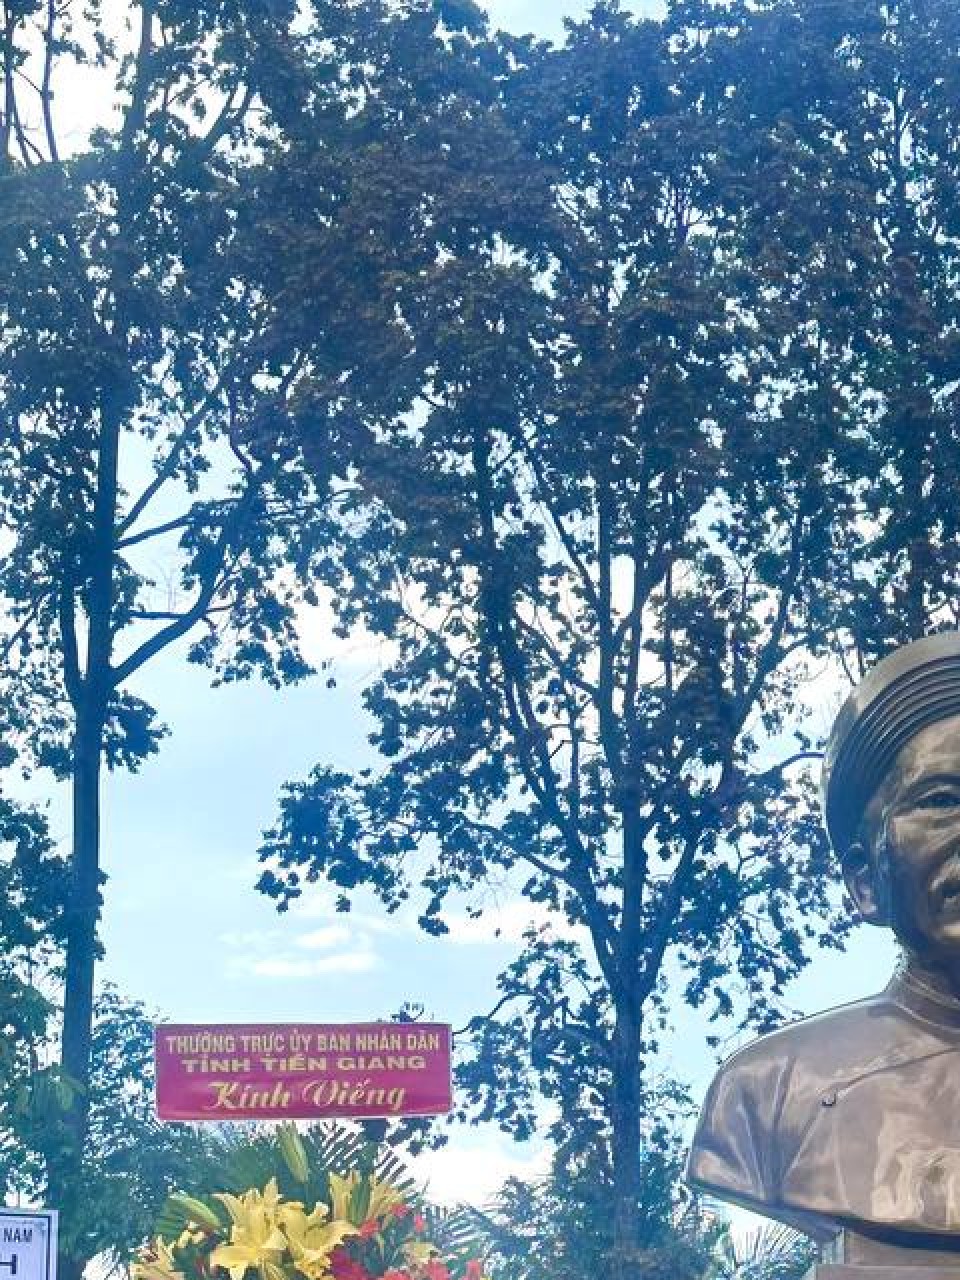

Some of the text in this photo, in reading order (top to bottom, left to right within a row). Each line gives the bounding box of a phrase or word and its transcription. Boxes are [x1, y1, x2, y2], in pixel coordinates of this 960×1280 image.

[317, 1032, 351, 1052] BAN
[336, 1056, 426, 1070] GIANG
[203, 1078, 405, 1111] Kính Viếng
